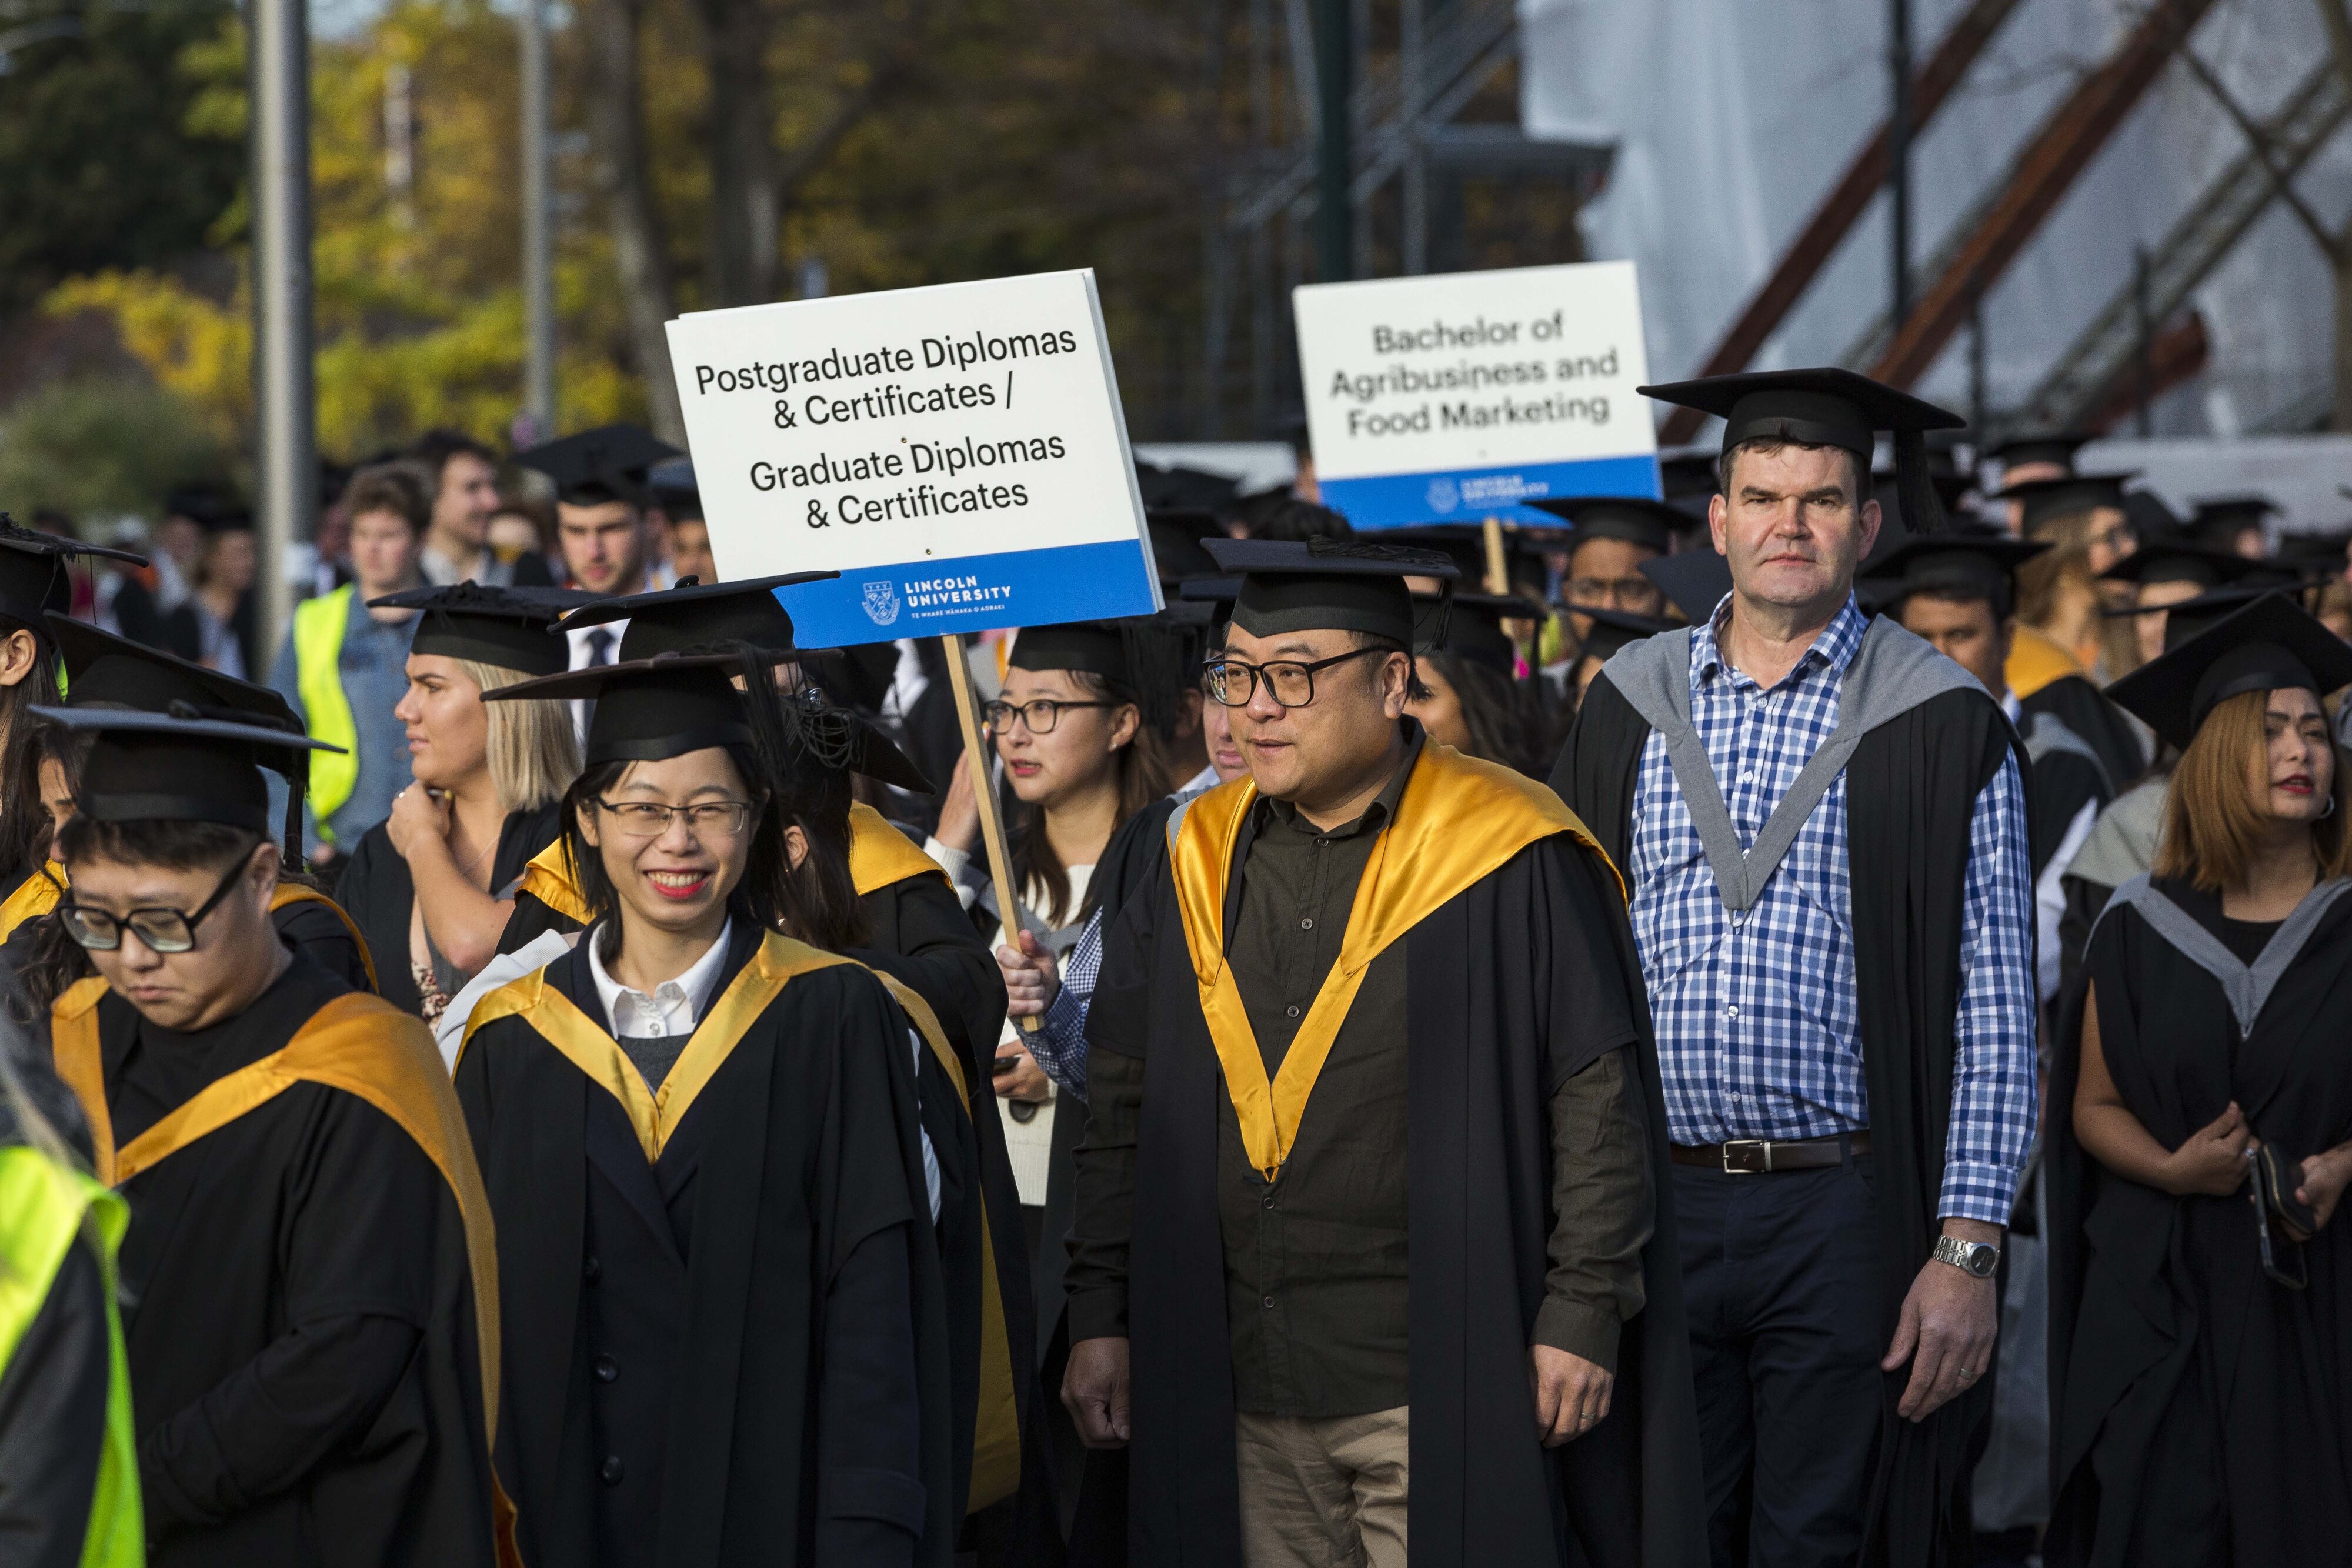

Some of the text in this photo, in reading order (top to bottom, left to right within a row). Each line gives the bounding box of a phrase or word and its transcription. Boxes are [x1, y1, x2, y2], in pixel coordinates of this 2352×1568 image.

[1372, 309, 1564, 355] Bachelor of
[695, 330, 1076, 395] Postgraduate Diplomas
[1329, 347, 1619, 403] Agribusiness and
[774, 370, 1014, 429] & Certificates /
[1347, 396, 1611, 437] Food Marketing
[750, 435, 1065, 491] Graduate Diplomas
[807, 483, 1029, 529] & Certificates
[905, 575, 977, 593] LINCOLN
[908, 586, 1011, 607] UNIVERSITY
